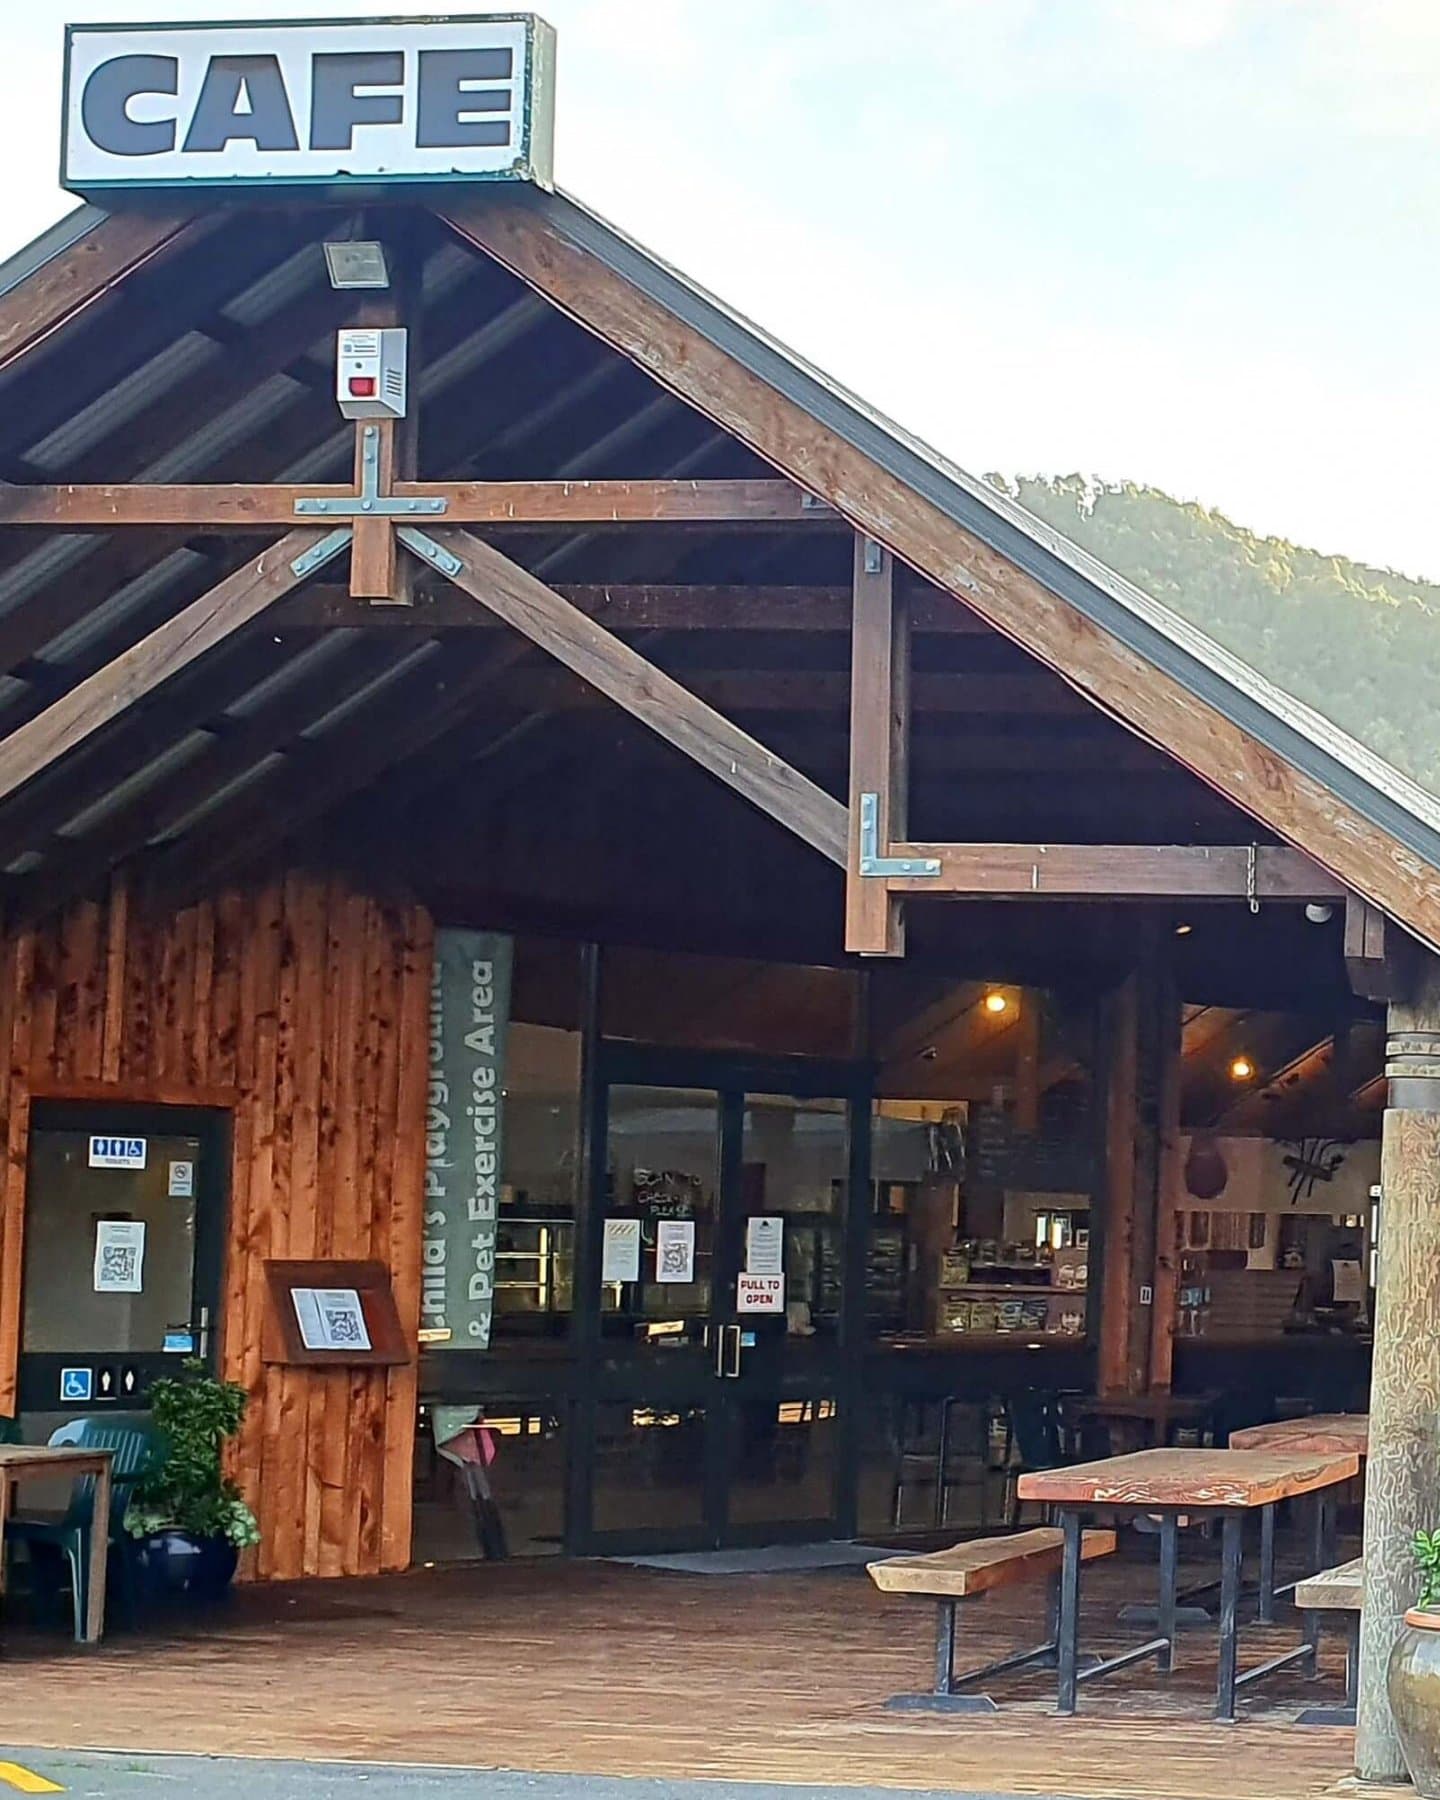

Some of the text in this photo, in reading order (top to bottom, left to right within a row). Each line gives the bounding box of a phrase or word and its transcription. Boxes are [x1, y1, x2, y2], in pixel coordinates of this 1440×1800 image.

[80, 47, 513, 157] CAFE
[464, 960, 497, 1341] & Pet Exercise Area
[741, 1280, 780, 1290] PULL TO
[746, 1294, 773, 1304] OPEN
